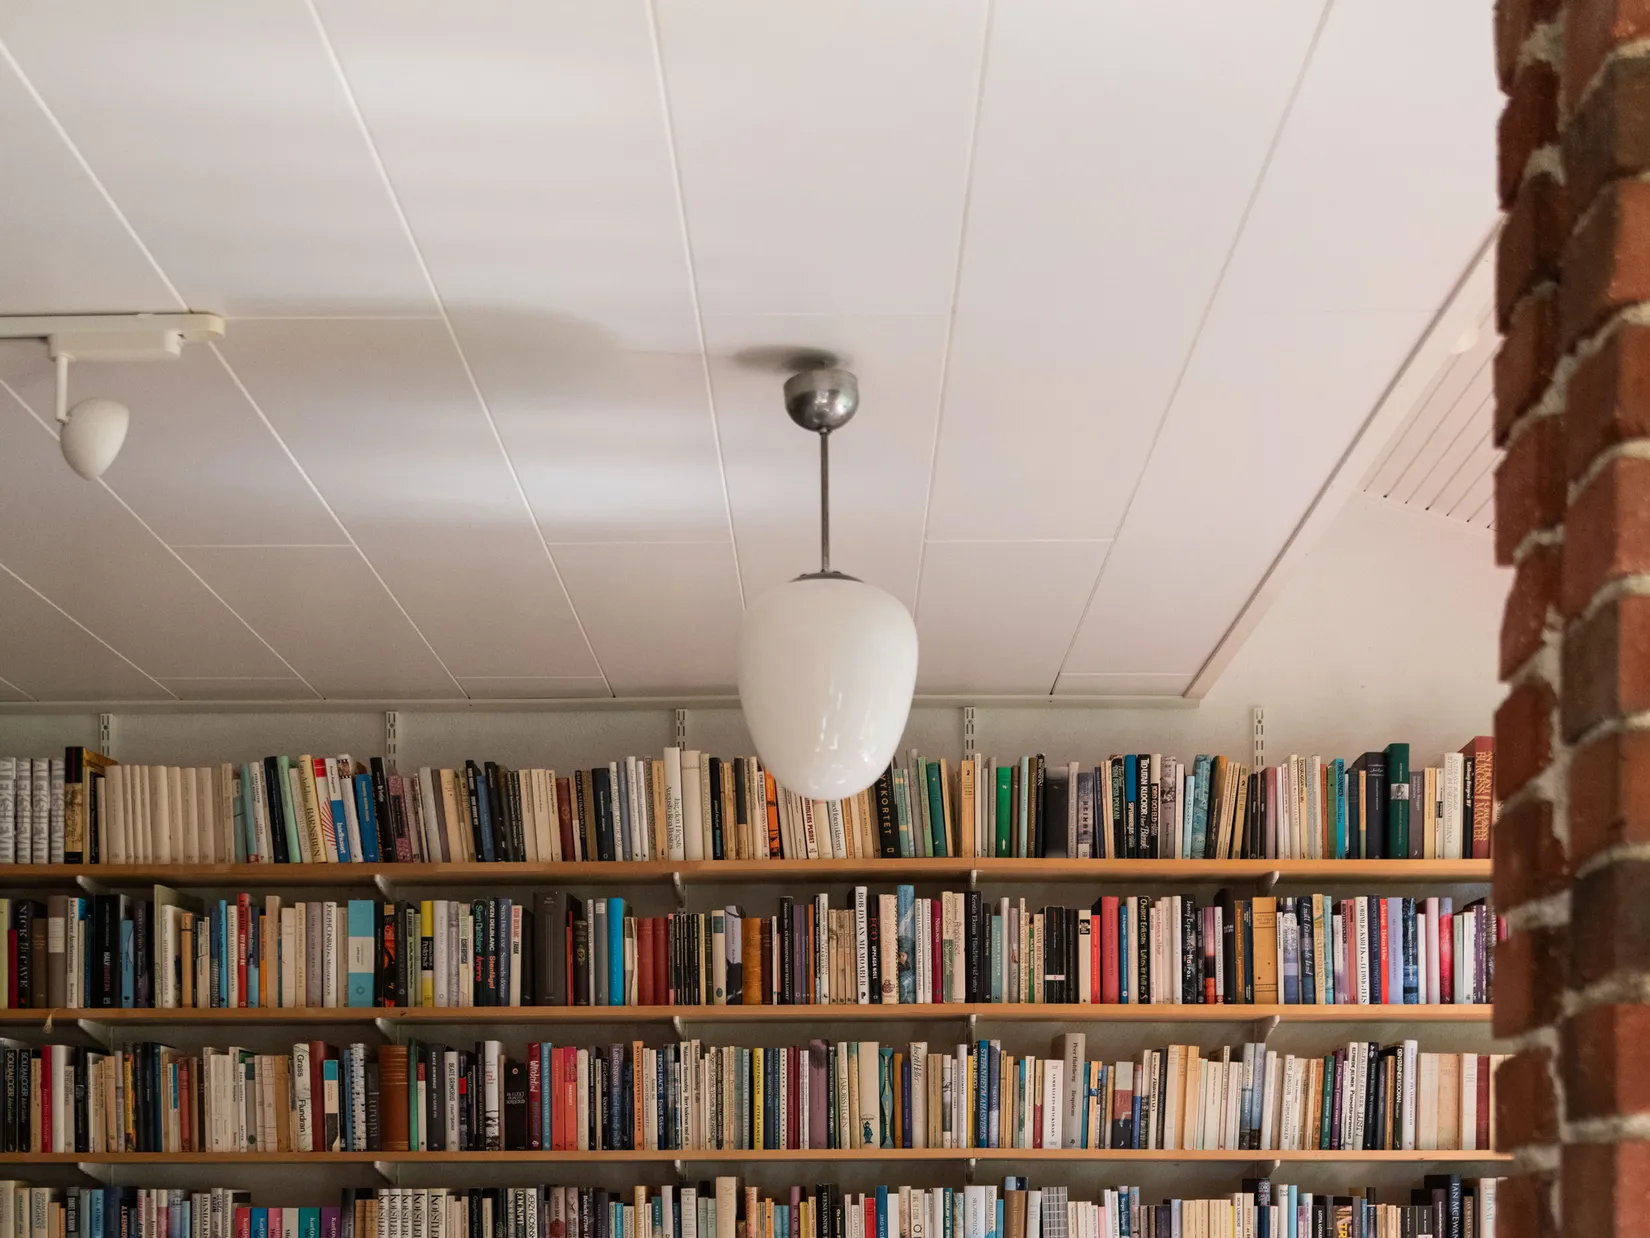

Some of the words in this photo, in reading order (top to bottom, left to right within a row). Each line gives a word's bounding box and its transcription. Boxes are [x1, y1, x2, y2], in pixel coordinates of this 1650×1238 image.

[879, 774, 891, 835] VYKORTET
[337, 822, 346, 854] badhuset
[1185, 900, 1193, 917] Jenny
[859, 940, 867, 986] MEMOARER
